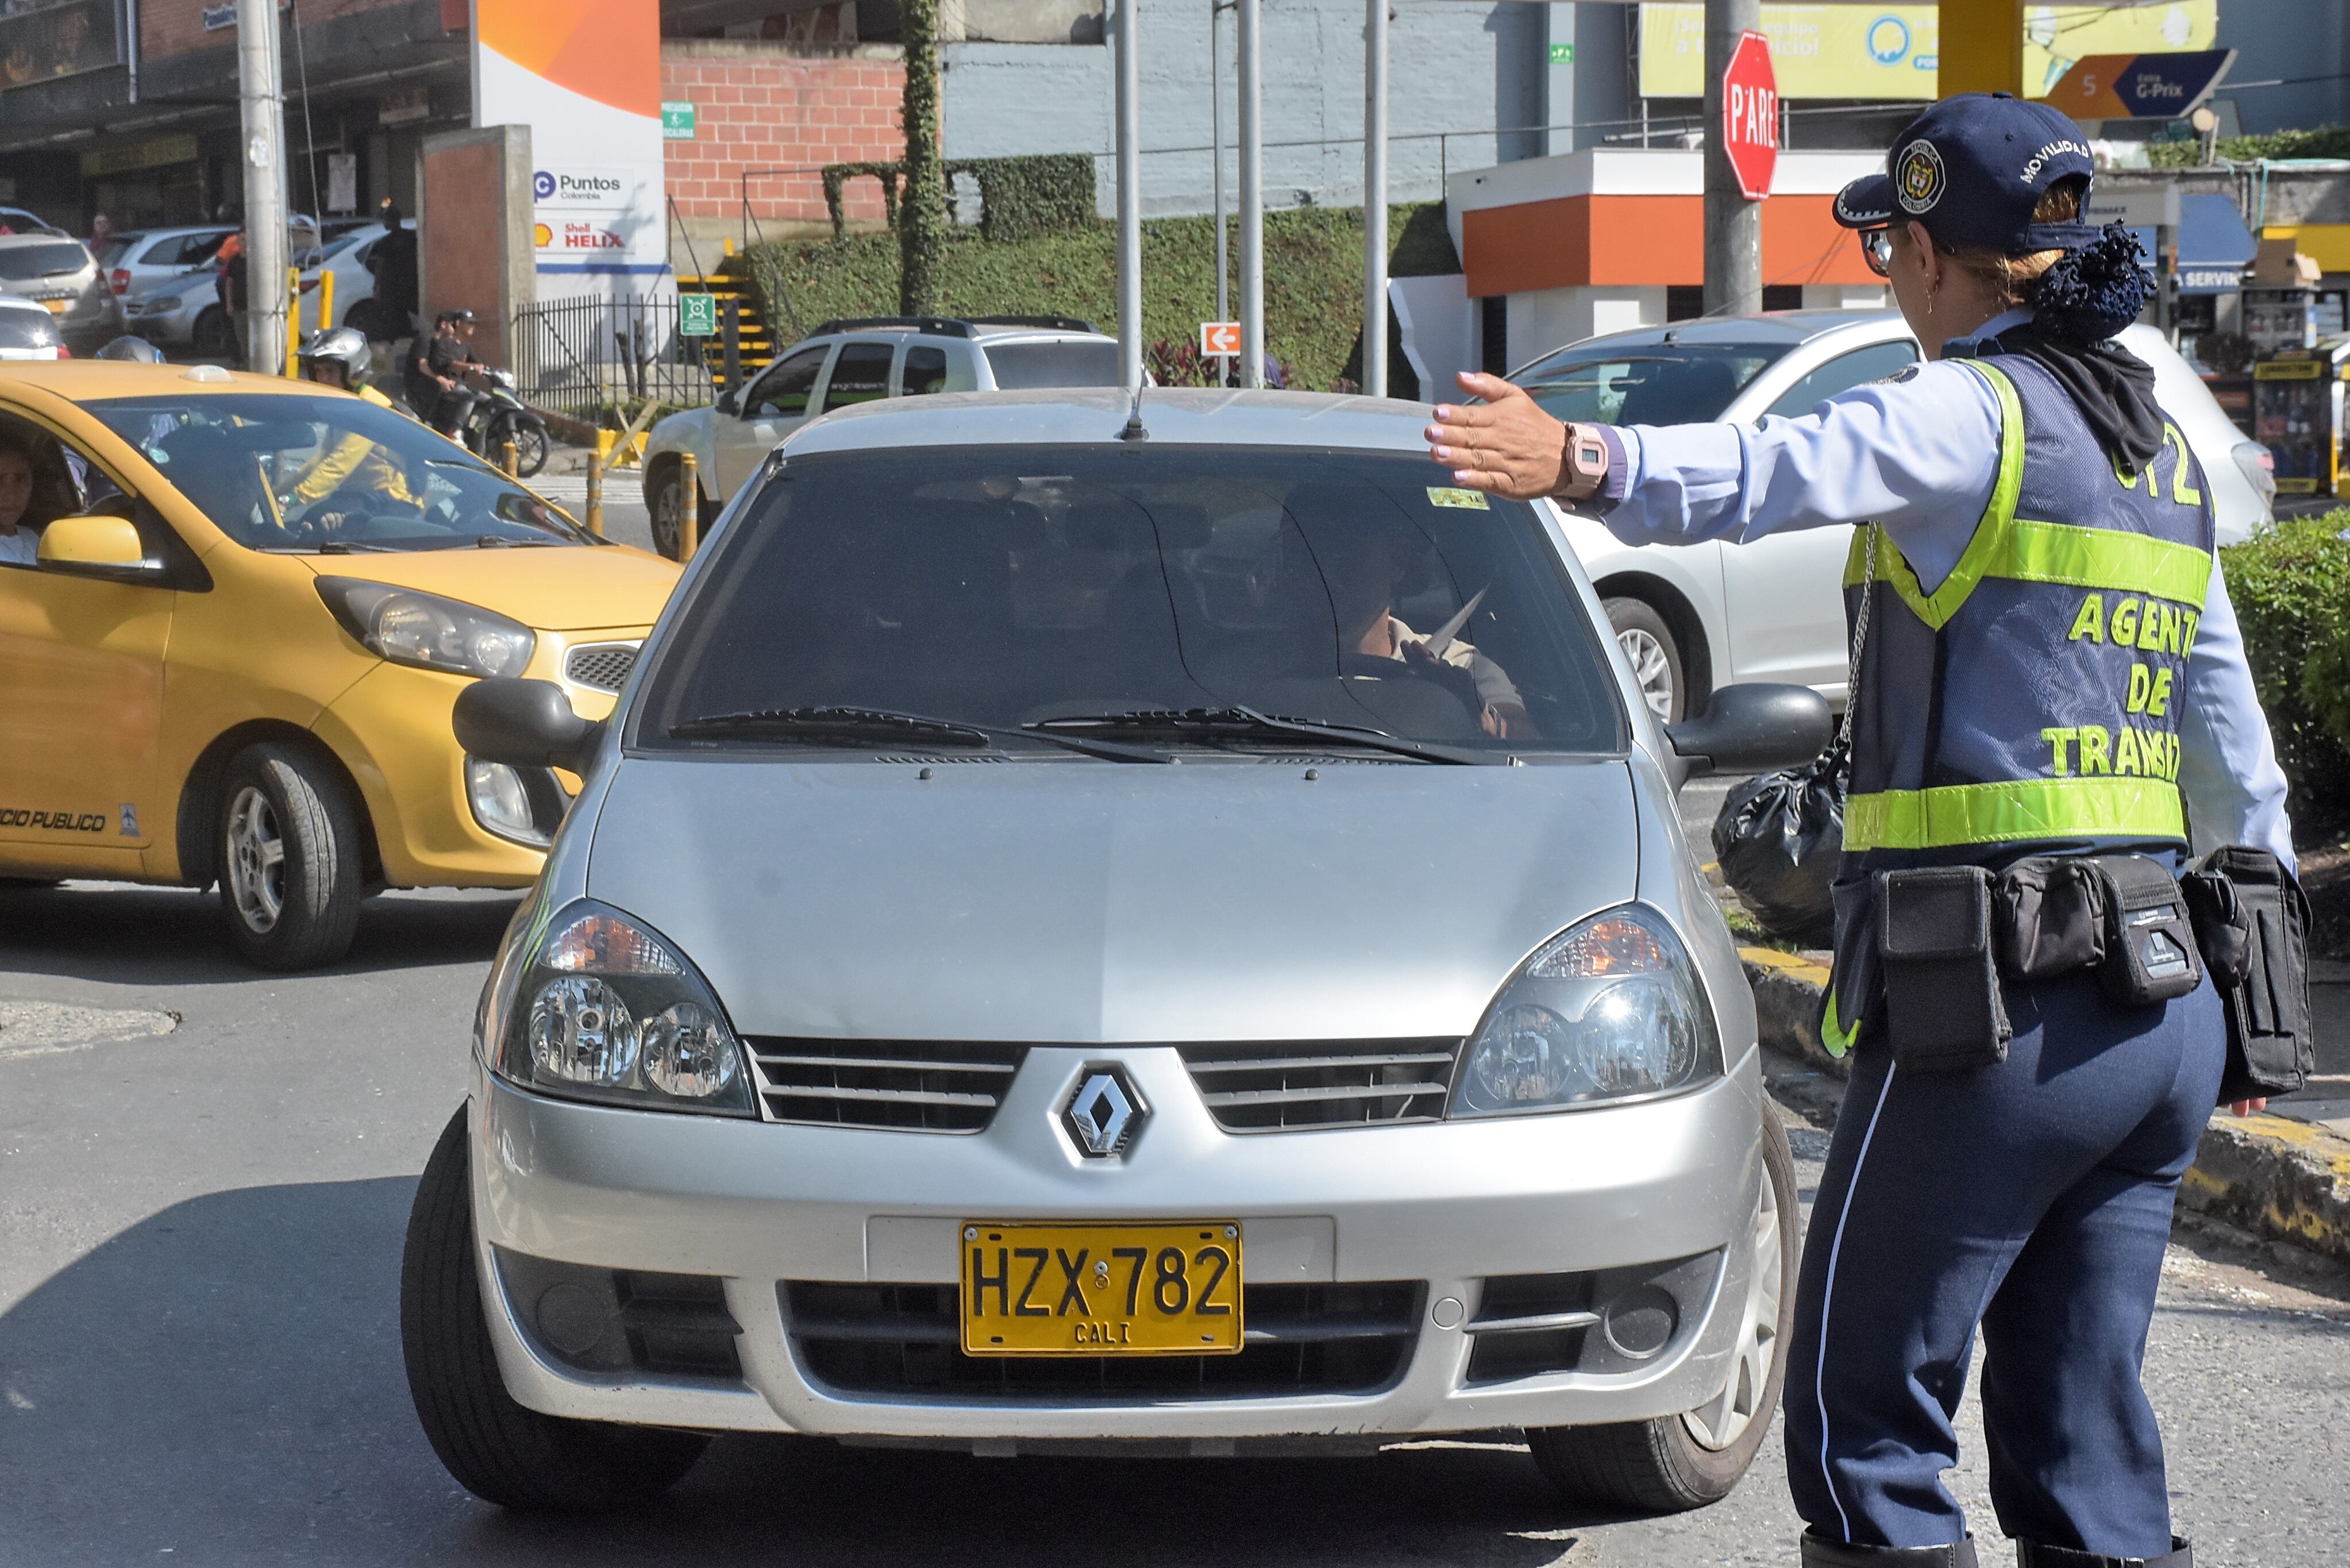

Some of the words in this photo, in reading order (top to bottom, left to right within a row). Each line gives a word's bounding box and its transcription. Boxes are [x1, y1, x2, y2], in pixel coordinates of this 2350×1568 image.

[2083, 74, 2097, 97] 5
[2136, 82, 2183, 99] G-Prix
[1731, 83, 1775, 148] PARE
[2020, 140, 2089, 184] MOVILIDAD
[560, 175, 621, 191] Puntos
[565, 222, 591, 233] Shell
[565, 231, 626, 248] HELIX
[2068, 593, 2199, 663] AGENT
[2127, 663, 2172, 716] DE
[30, 811, 106, 832] PUBLICO
[972, 1247, 1092, 1317] HZX
[1112, 1245, 1232, 1316] 782
[1075, 1323, 1131, 1344] CALI
